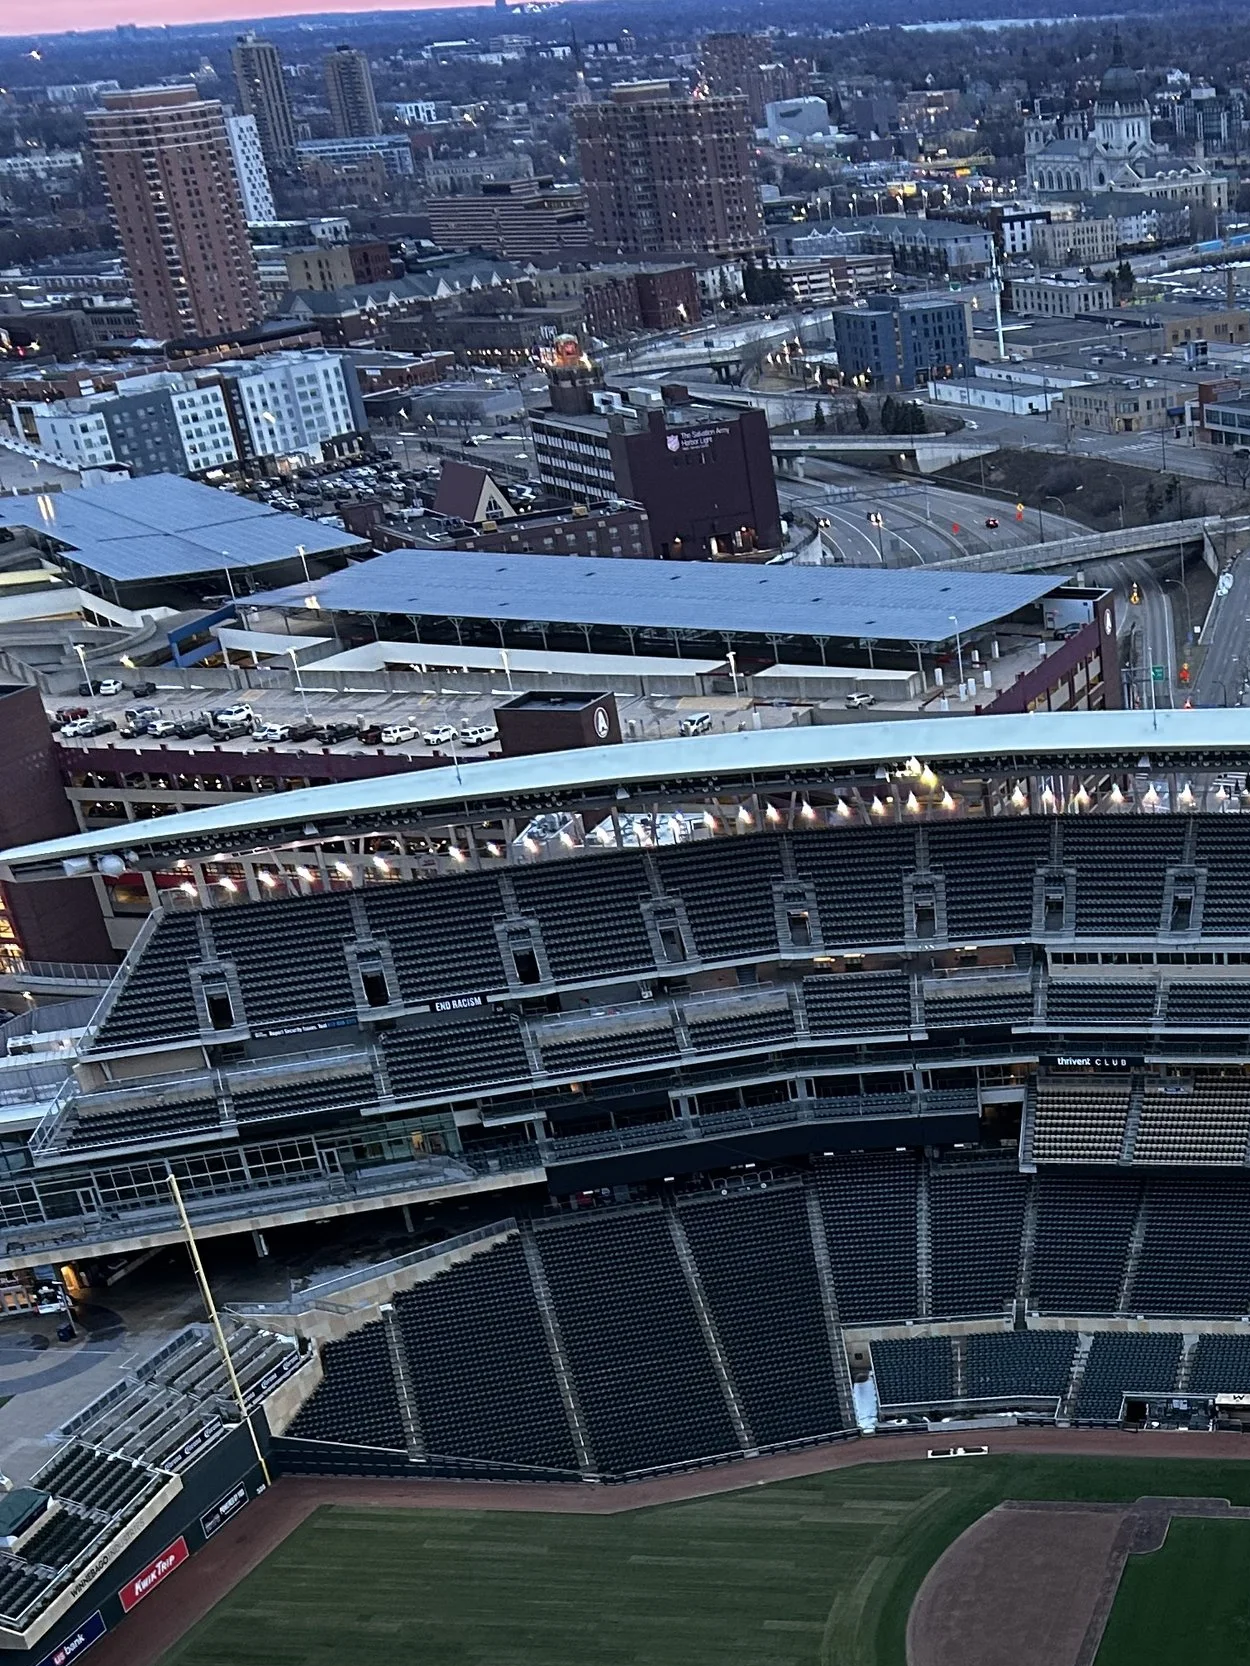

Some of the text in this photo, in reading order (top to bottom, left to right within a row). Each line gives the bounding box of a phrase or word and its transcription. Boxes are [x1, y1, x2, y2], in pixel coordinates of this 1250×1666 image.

[692, 429, 715, 438] Salvation
[435, 996, 482, 1012] END RACISM
[1057, 1057, 1091, 1066] thrivent
[70, 1556, 109, 1598] WINNEBAGO
[63, 1633, 86, 1655] bank
